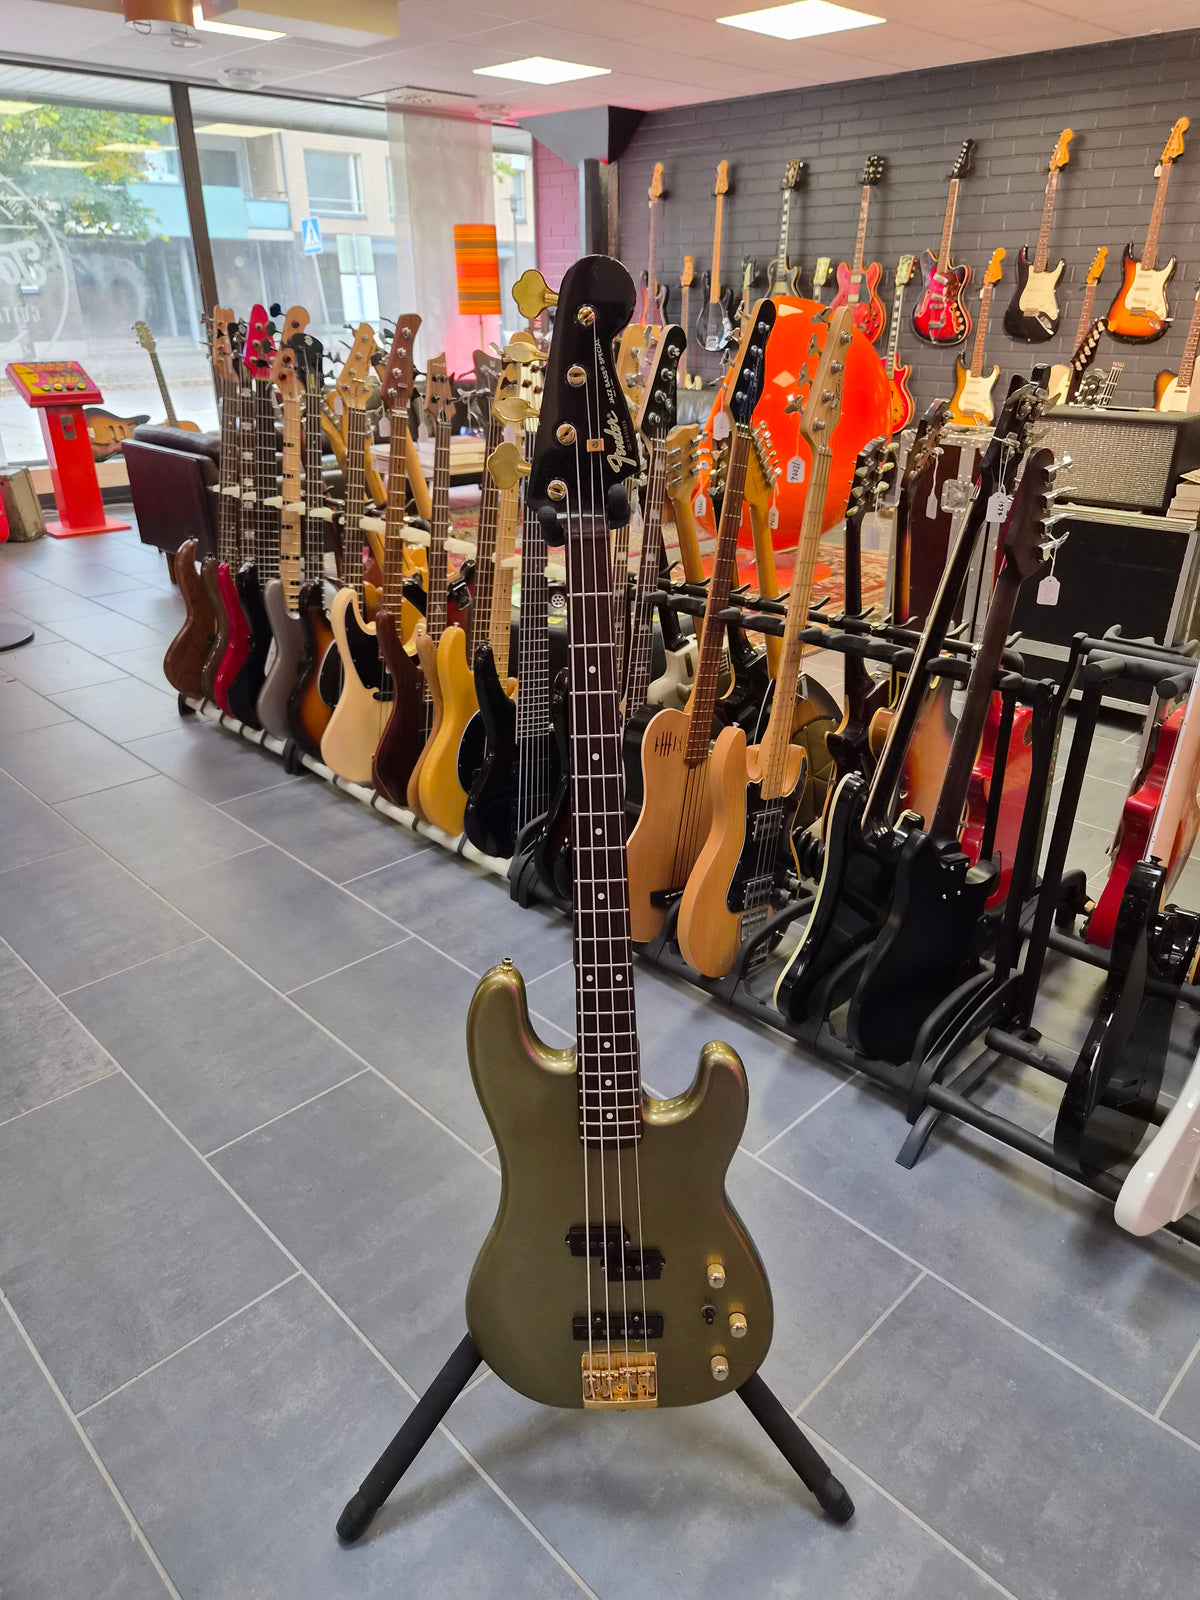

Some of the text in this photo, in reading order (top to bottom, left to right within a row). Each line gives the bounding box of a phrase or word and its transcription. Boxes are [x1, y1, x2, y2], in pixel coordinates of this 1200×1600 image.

[596, 338, 605, 365] SPECIAL
[606, 387, 615, 405] JAZZ
[603, 410, 637, 473] Fender
